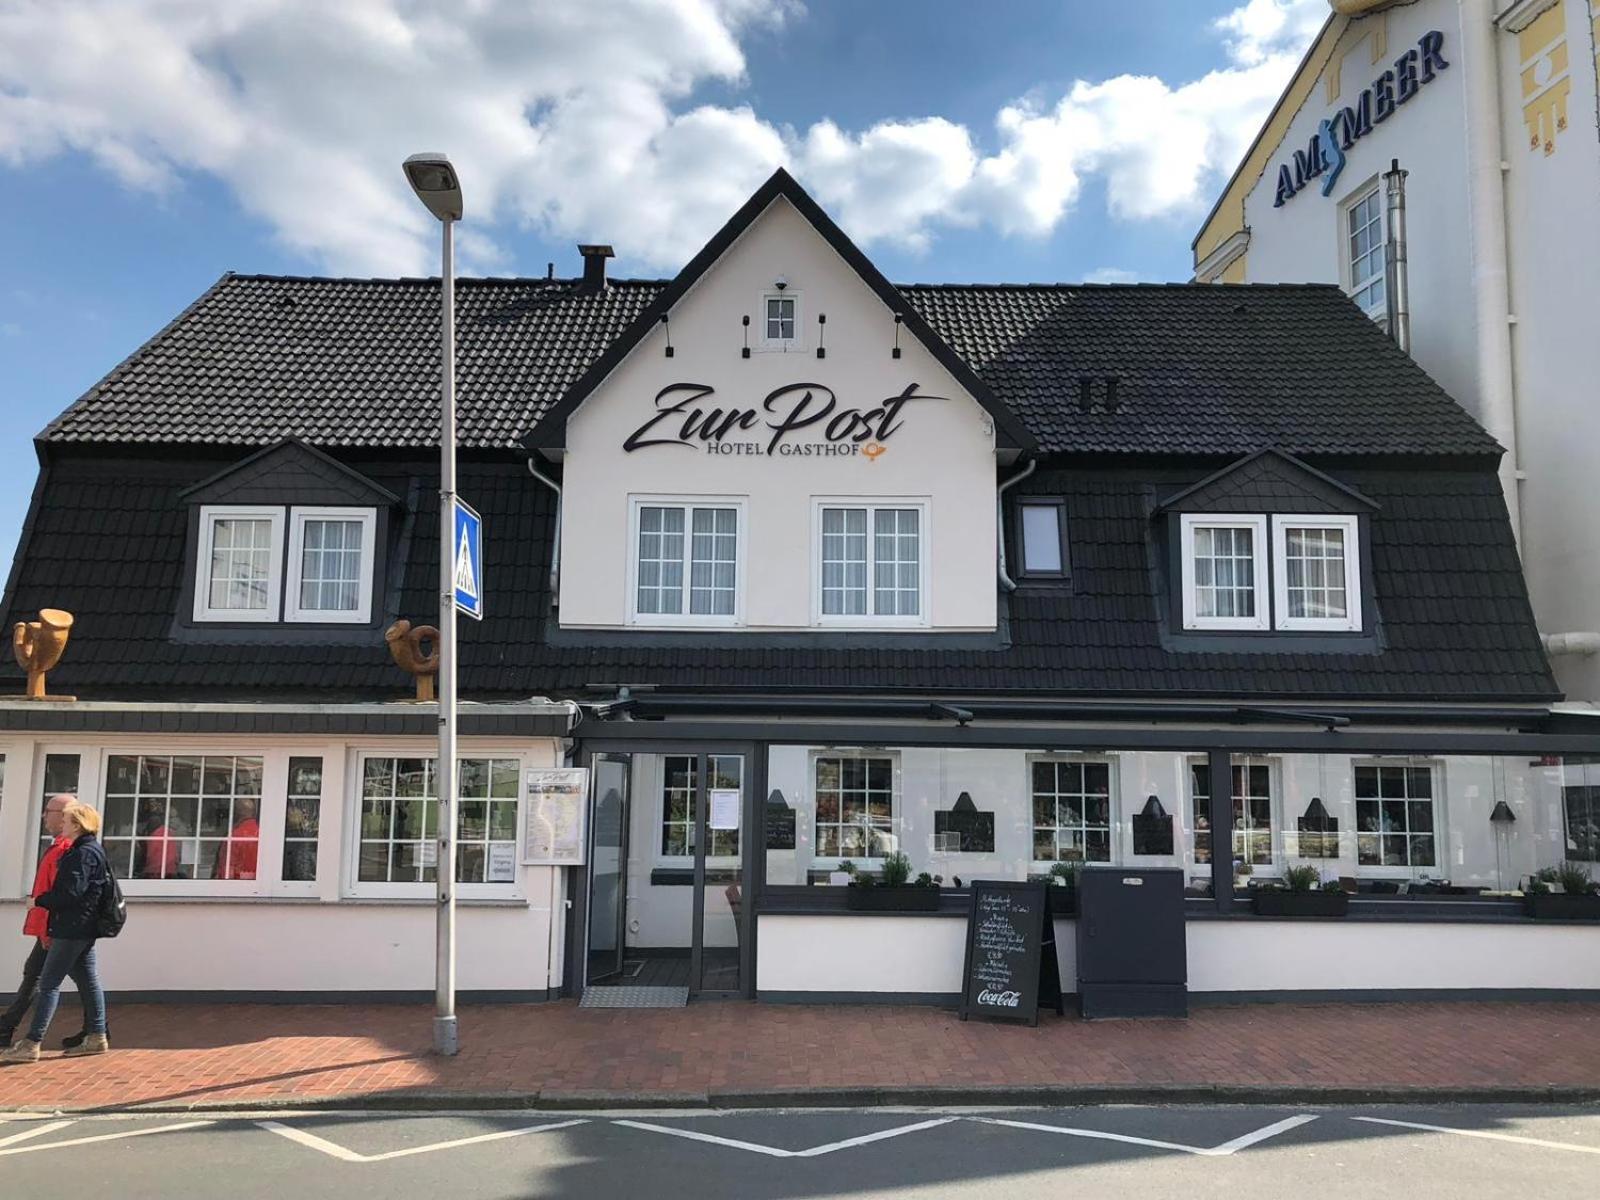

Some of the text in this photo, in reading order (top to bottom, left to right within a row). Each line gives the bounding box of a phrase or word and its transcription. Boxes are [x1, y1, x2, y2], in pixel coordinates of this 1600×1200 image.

[623, 382, 950, 456] Zur Post
[707, 441, 861, 457] HOTEL GASTHOF
